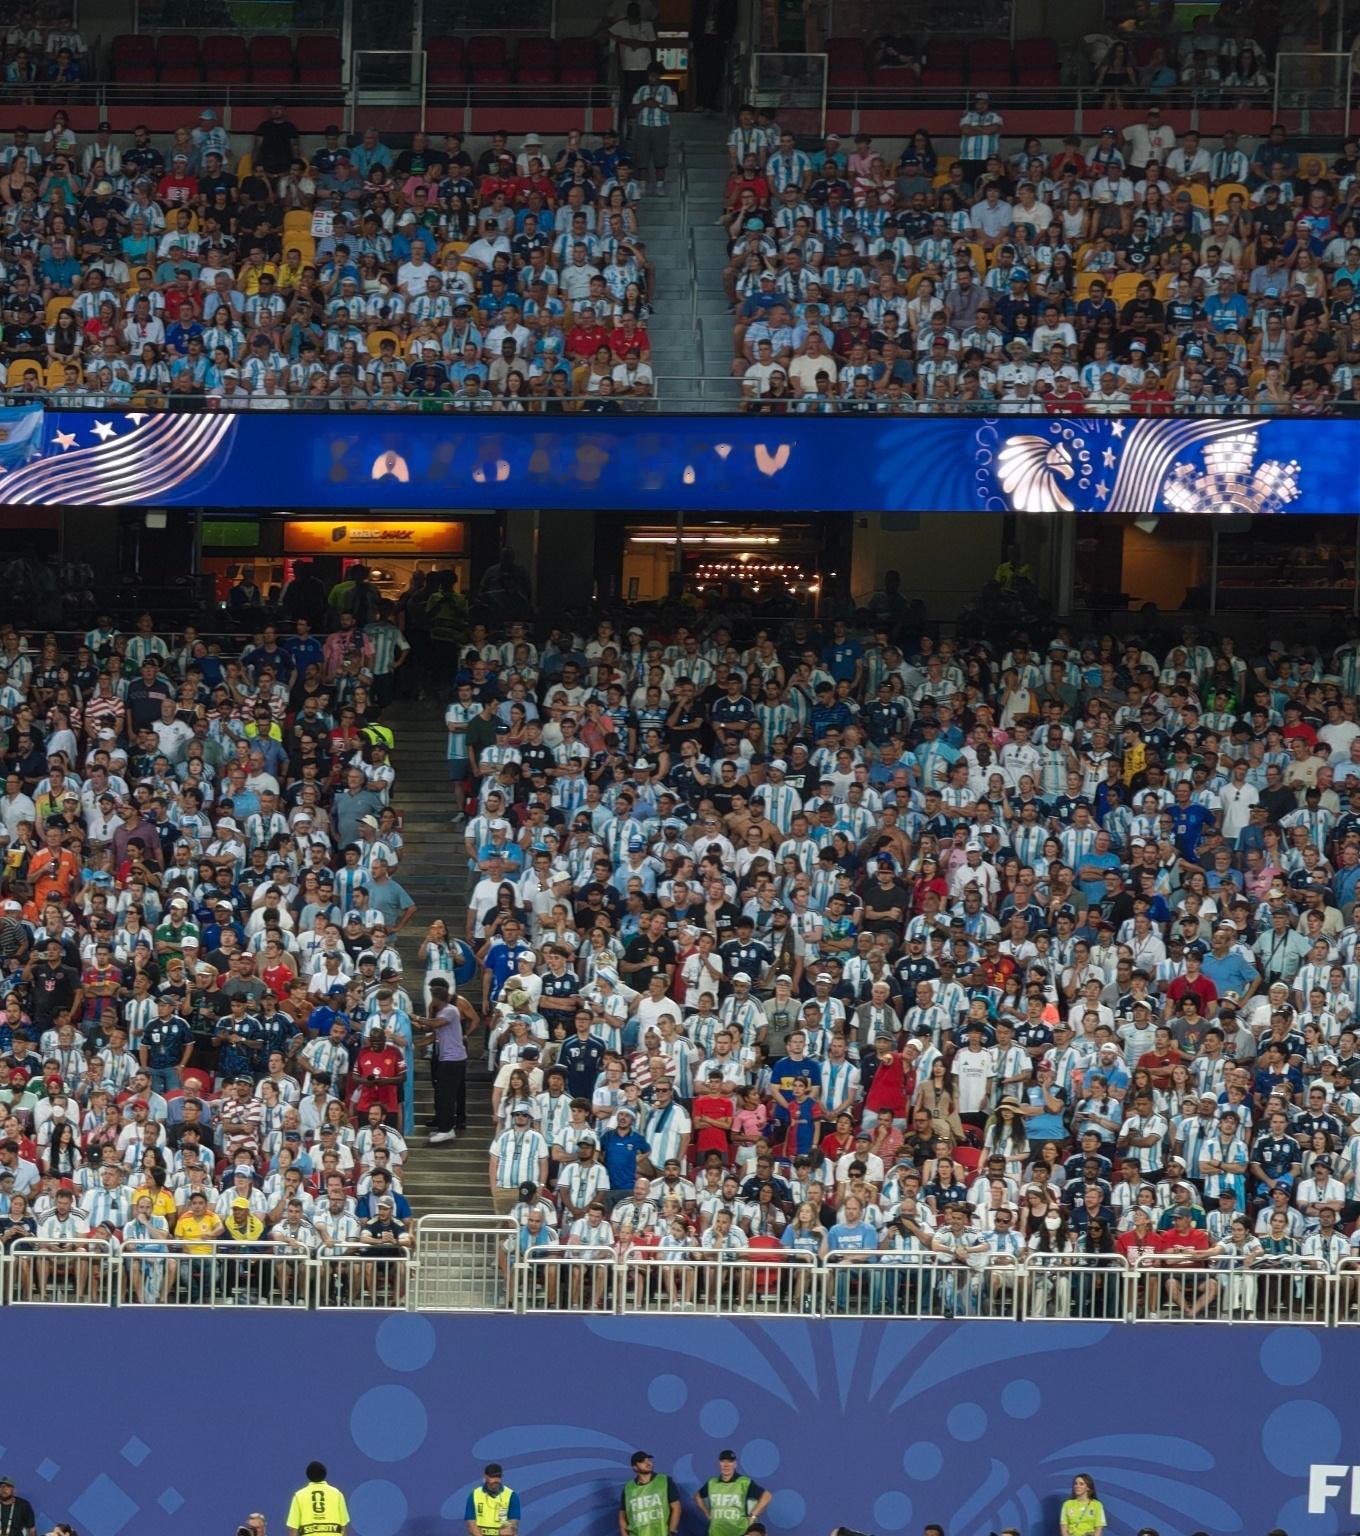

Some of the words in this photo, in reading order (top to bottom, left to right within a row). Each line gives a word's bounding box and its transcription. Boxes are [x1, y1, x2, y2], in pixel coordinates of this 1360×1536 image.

[631, 1493, 662, 1511] FIFA
[710, 1494, 741, 1507] FIFA
[712, 1508, 740, 1520] ITCH
